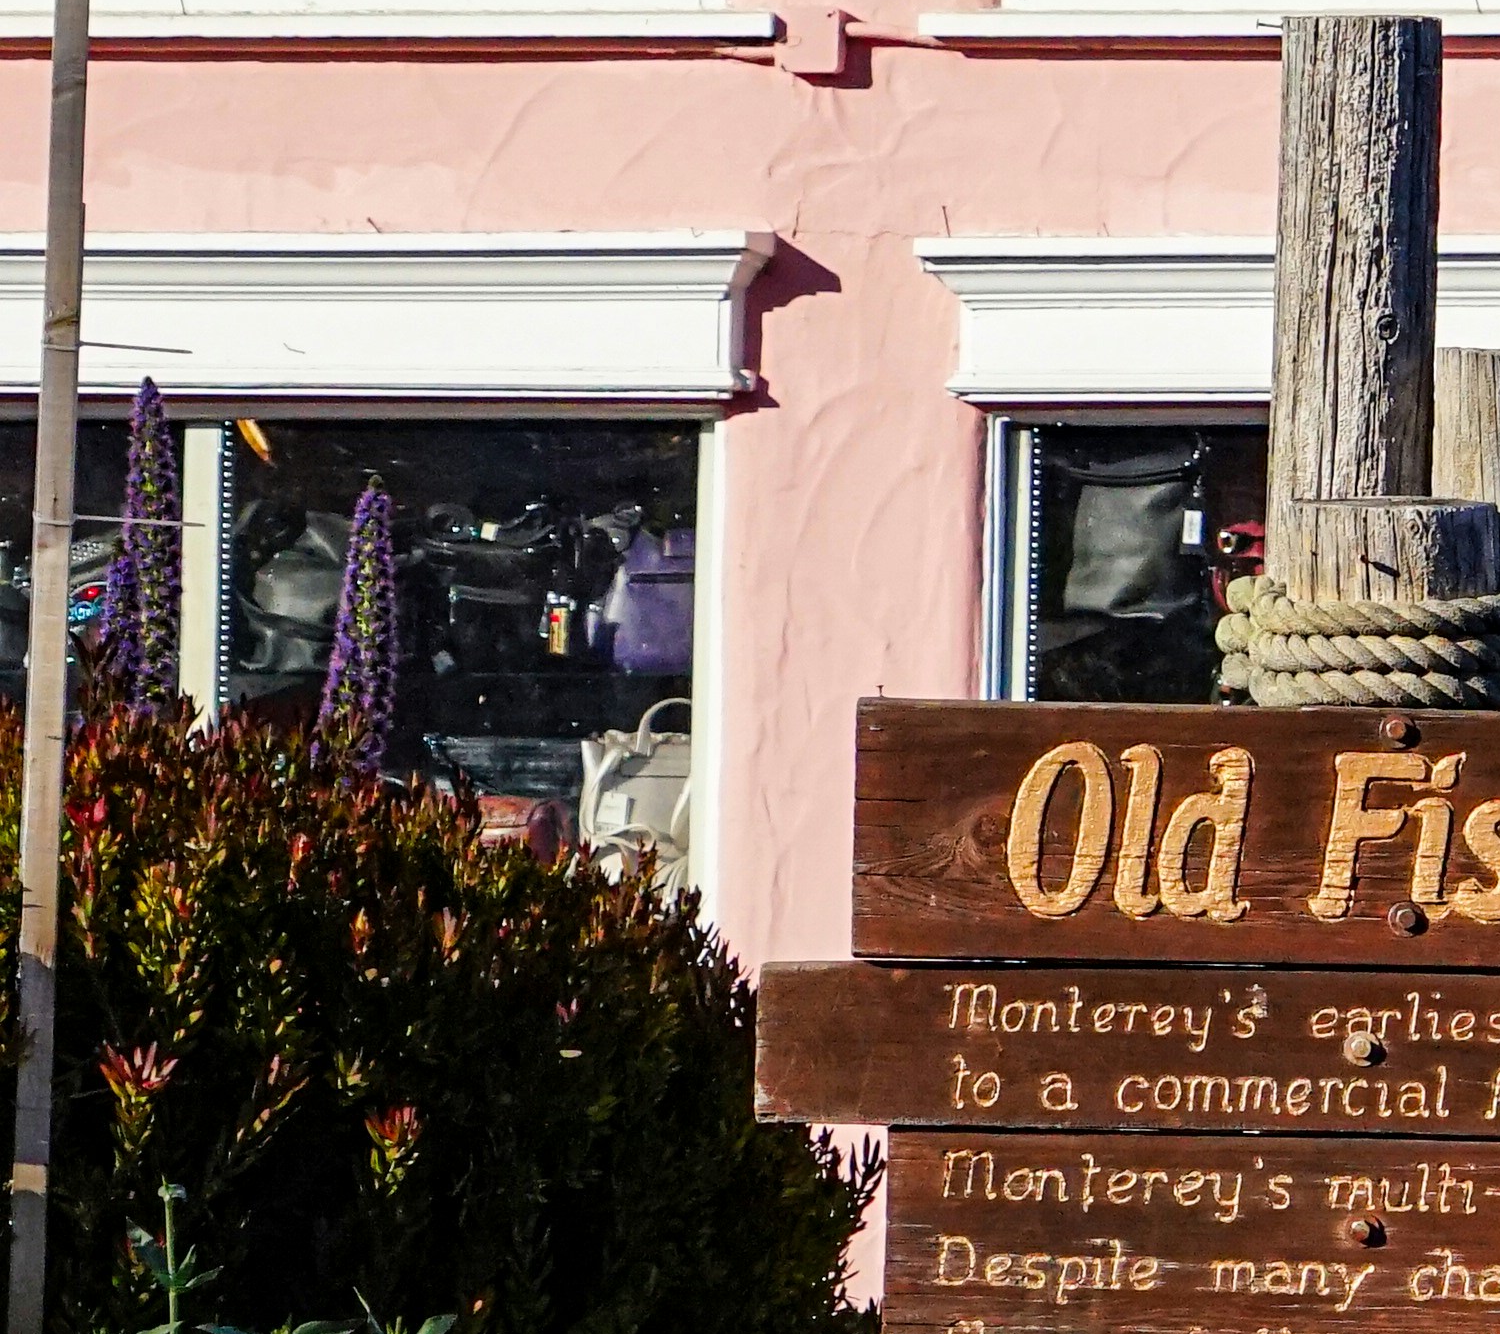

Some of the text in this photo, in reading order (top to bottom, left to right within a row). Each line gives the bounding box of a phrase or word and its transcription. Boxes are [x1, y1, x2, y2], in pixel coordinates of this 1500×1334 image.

[1005, 742, 1257, 922] Old
[944, 984, 1262, 1052] Monterey's
[950, 1055, 1000, 1110] to
[1041, 1071, 1078, 1111] a
[1116, 1065, 1449, 1118] commercial
[941, 1150, 1293, 1224] Monterey's
[935, 1235, 1159, 1305] Despite
[1209, 1258, 1374, 1312] many
